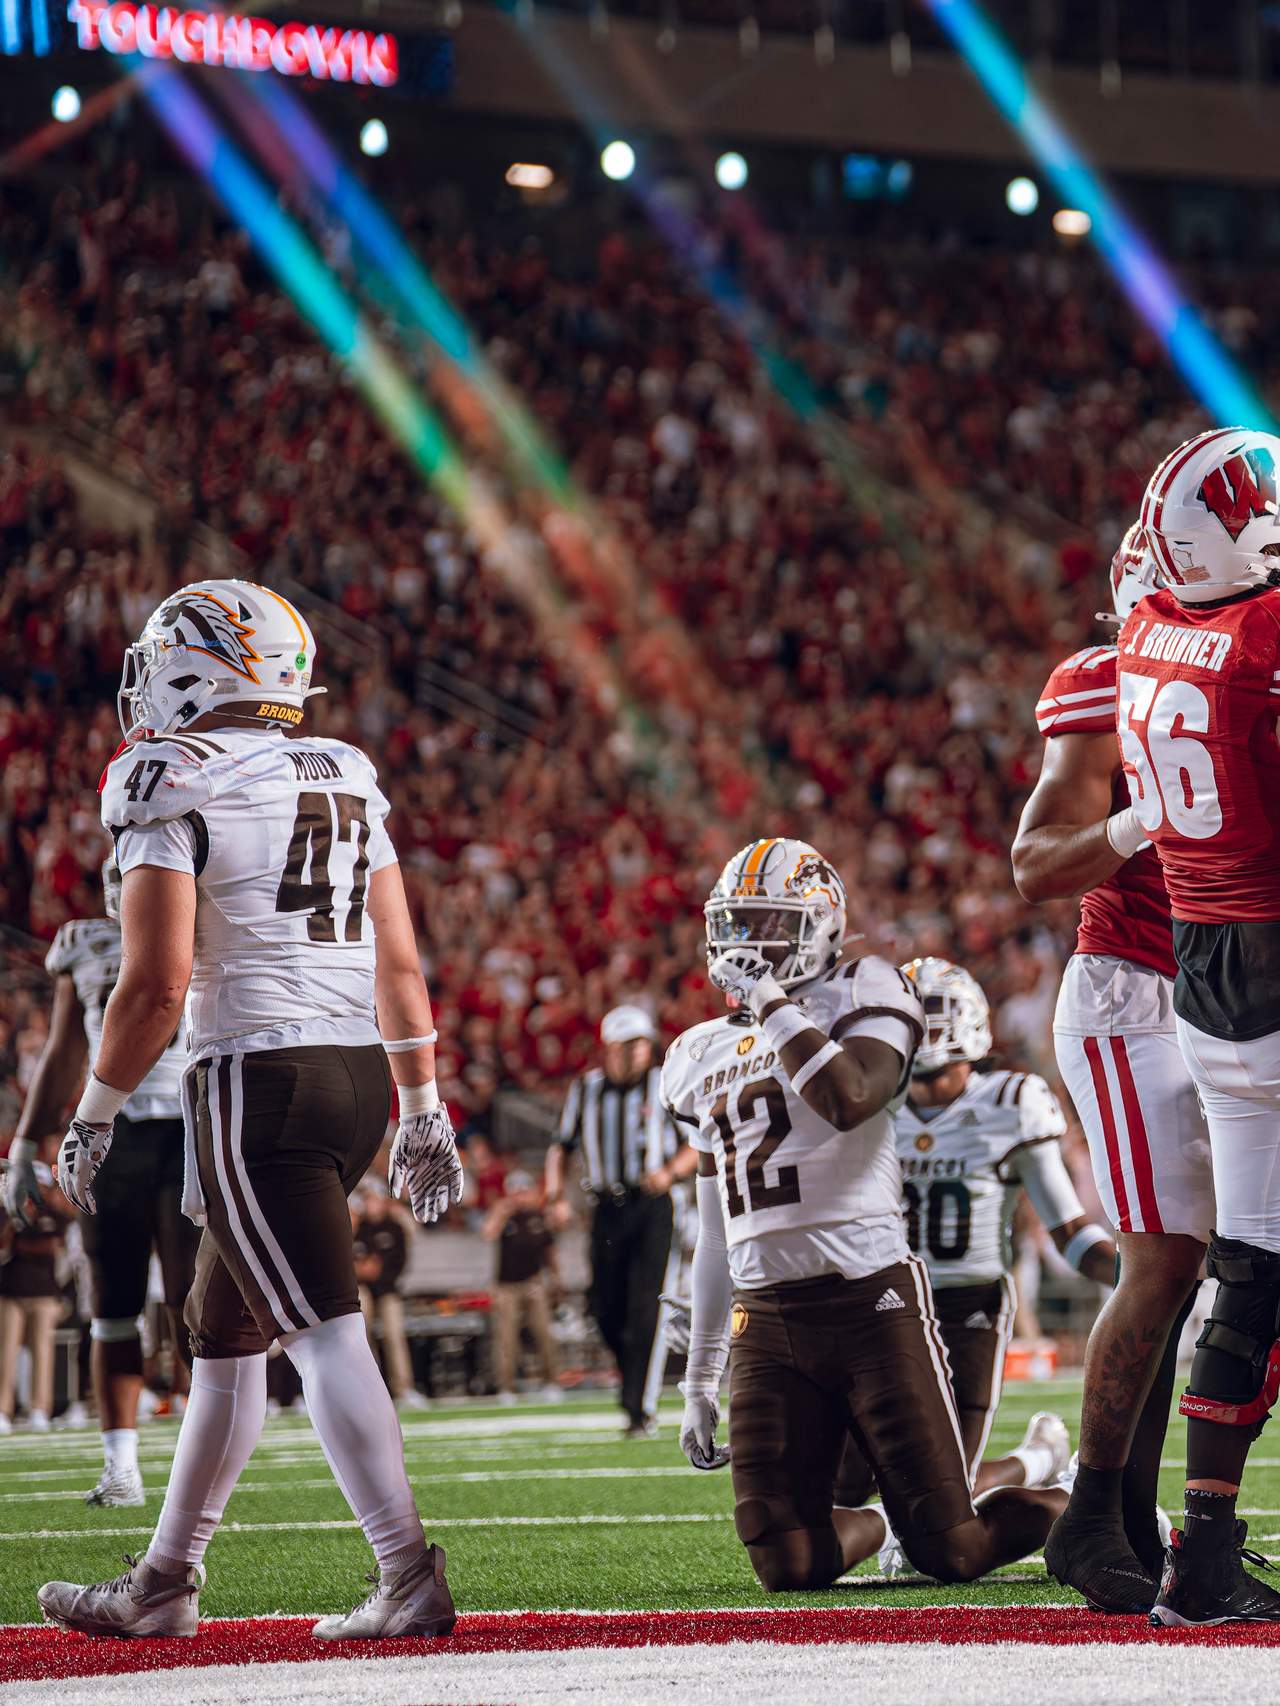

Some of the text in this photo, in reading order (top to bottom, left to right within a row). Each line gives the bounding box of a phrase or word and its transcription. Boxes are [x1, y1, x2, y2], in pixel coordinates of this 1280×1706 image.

[1139, 623, 1233, 672] BRUNNER
[283, 752, 343, 781] MOON
[1116, 671, 1223, 840] 56
[124, 759, 168, 802] 47
[704, 1051, 783, 1096] BRONCO
[710, 1076, 801, 1218] 12
[875, 1302, 906, 1311] adidas
